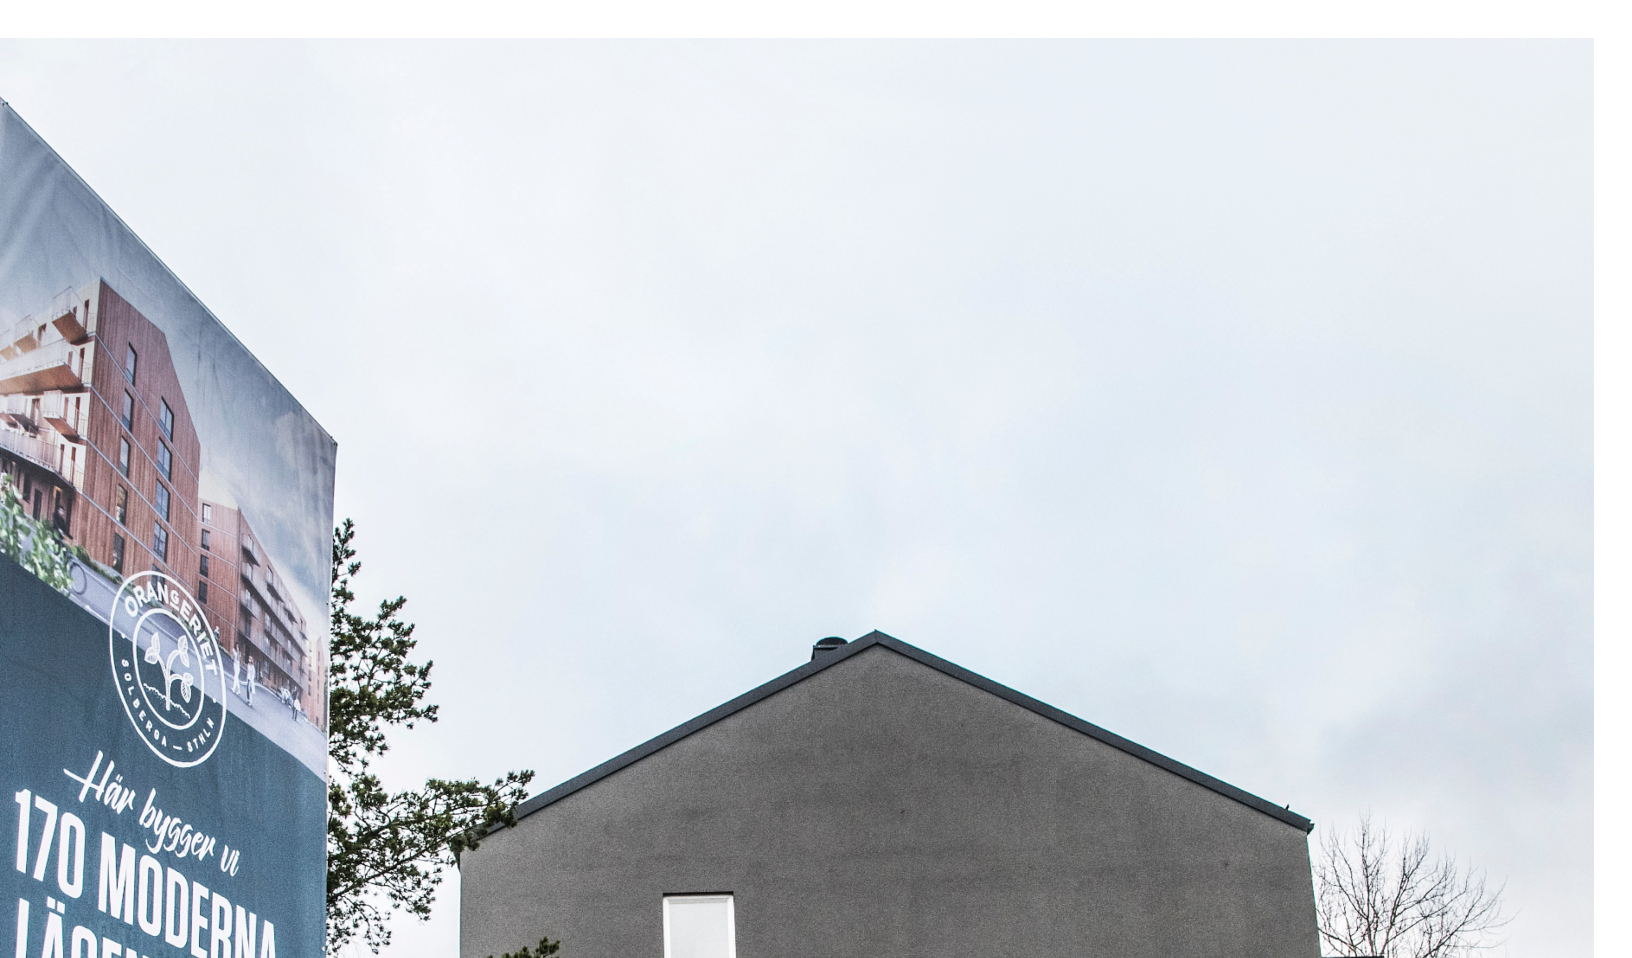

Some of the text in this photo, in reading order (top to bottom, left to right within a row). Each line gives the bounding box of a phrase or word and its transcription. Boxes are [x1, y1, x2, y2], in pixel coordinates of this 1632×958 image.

[124, 581, 217, 676] ORANGERIET
[121, 659, 167, 747] SOLBERGA
[15, 788, 86, 900] 170
[63, 750, 240, 877] Här bygger vi
